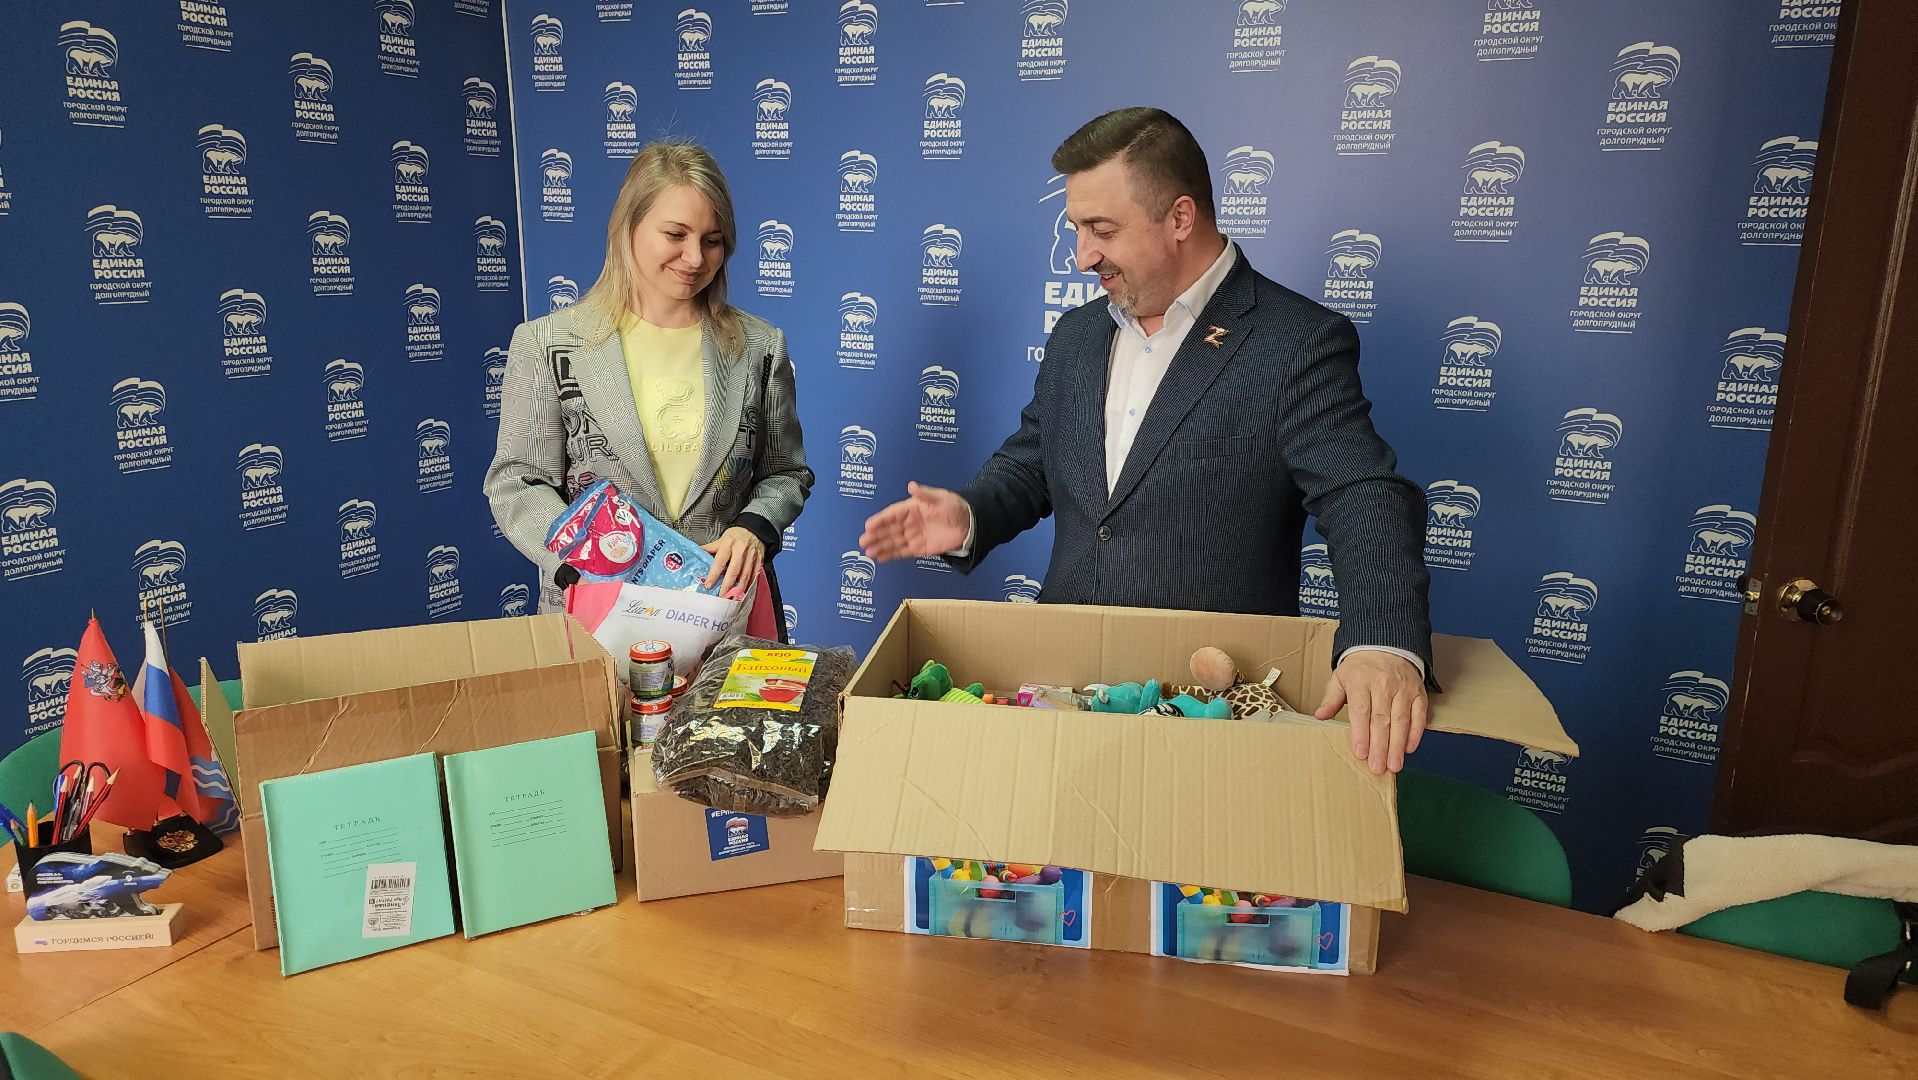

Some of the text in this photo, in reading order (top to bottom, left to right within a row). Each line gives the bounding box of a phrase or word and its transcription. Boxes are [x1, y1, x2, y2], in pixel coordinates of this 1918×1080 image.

[180, 1, 226, 16] ЕДИНАЯ
[180, 11, 227, 26] РОССИЯ
[1485, 11, 1540, 23] ЕДИНАЯ
[1235, 26, 1281, 37] ЕДИНАЯ
[1483, 22, 1539, 34] РОССИЯ
[380, 35, 414, 46] ЕДИНАЯ
[1022, 38, 1063, 48] ЕДИНАЯ
[1234, 37, 1281, 47] РОССИЯ
[1474, 36, 1544, 46] ГОРОДСКОЙ ОКРУГ
[381, 44, 415, 56] РОССИЯ
[839, 46, 874, 56] ЕДИНАЯ
[1022, 47, 1062, 57] РОССИЯ
[1477, 45, 1537, 56] ДОЛГОПРУДНЫЙ
[534, 56, 562, 64] ЕДИНАЯ
[678, 53, 709, 61] ЕДИНАЯ
[840, 56, 874, 64] РОССИЯ
[679, 61, 710, 69] РОССИЯ
[66, 76, 118, 90] ЕДИНАЯ
[68, 87, 120, 101] РОССИЯ
[63, 102, 128, 113] ГОРОДСКОЙ ОКРУГ
[294, 100, 333, 111] ЕДИНАЯ
[1608, 101, 1668, 112] ЕДИНАЯ
[69, 112, 125, 122] ДОЛГОПРУДНЫЙ
[296, 110, 334, 121] РОССИЯ
[1342, 110, 1391, 120] ЕДИНАЯ
[1607, 112, 1666, 123] РОССИЯ
[466, 119, 496, 128] ЕДИНАЯ
[607, 123, 635, 131] ЕДИНАЯ
[756, 122, 788, 130] ЕДИНАЯ
[924, 120, 961, 129] ЕДИНАЯ
[1341, 120, 1391, 130] РОССИЯ
[467, 128, 497, 137] РОССИЯ
[607, 131, 636, 139] РОССИЯ
[756, 131, 788, 139] РОССИЯ
[924, 129, 961, 138] РОССИЯ
[1597, 127, 1644, 136] ГОРОДСКОЙ
[1334, 133, 1373, 141] ГОРОДСКОЙ
[1600, 136, 1664, 145] ДОЛГОПРУДНЫЙ
[1336, 141, 1390, 151] ДОЛГОПРУДНЫЙ
[203, 175, 246, 185] ЕДИНАЯ
[205, 185, 248, 195] РОССИЯ
[395, 185, 428, 193] ЕДИНАЯ
[396, 194, 429, 202] РОССИЯ
[1219, 195, 1267, 206] ЕДИНАЯ
[1461, 197, 1514, 206] ЕДИНАЯ
[840, 203, 874, 211] РОССИЯ
[1219, 206, 1266, 216] РОССИЯ
[1460, 207, 1513, 216] РОССИЯ
[1747, 208, 1807, 217] РОССИЯ
[1451, 220, 1493, 228] ГОРОДСКОЙ
[1454, 229, 1512, 237] ДОЛГОПРУДНЫЙ
[93, 259, 143, 269] ЕДИНАЯ
[312, 257, 349, 265] ЕДИНАЯ
[759, 261, 790, 269] ЕДИНАЯ
[94, 269, 145, 279] РОССИЯ
[314, 266, 350, 274] РОССИЯ
[760, 270, 791, 278] РОССИЯ
[923, 268, 958, 276] ЕДИНАЯ
[90, 282, 129, 290] ГОРОДСКОЙ
[923, 277, 958, 285] РОССИЯ
[1325, 280, 1373, 289] ЕДИНАЯ
[95, 290, 149, 300] ДОЛГОПРУДНЫЙ
[1323, 290, 1372, 300] РОССИЯ
[1580, 287, 1638, 296] ЕДИНАЯ
[1579, 297, 1637, 307] РОССИЯ
[1573, 320, 1635, 328] ДОЛГОПРУДНЫЙ
[408, 326, 439, 334] ЕДИНАЯ
[224, 336, 266, 347] ЕДИНАЯ
[409, 333, 440, 342] РОССИЯ
[841, 333, 873, 341] ЕДИНАЯ
[225, 345, 267, 356] РОССИЯ
[841, 341, 873, 350] РОССИЯ
[1440, 367, 1492, 377] ЕДИНАЯ
[18, 376, 41, 385] ОКРУГ
[1439, 376, 1491, 387] РОССИЯ
[1718, 382, 1778, 393] ЕДИНАЯ
[1432, 389, 1472, 397] ГОРОДСКОЙ
[1434, 398, 1490, 407] ДОЛГОПРУДНЫЙ
[1716, 393, 1777, 405] РОССИЯ
[328, 401, 363, 412] ЕДИНАЯ
[921, 406, 955, 415] ЕДИНАЯ
[329, 410, 364, 421] РОССИЯ
[921, 414, 955, 424] РОССИЯ
[117, 426, 165, 439] ЕДИНАЯ
[119, 435, 167, 450] РОССИЯ
[651, 443, 701, 453] LILBEA
[114, 447, 174, 460] ГОРОДСКОЙ ОКРУГ
[119, 455, 171, 470] ДОЛГОПРУДНЫЙ
[419, 456, 449, 467] ЕДИНАЯ
[1556, 457, 1612, 469] ЕДИНАЯ
[420, 463, 450, 475] РОССИЯ
[841, 464, 873, 473] ЕДИНАЯ
[841, 471, 873, 481] РОССИЯ
[1555, 468, 1610, 480] РОССИЯ
[1547, 480, 1590, 491] ГОРОДСКОЙ
[242, 486, 282, 500] ЕДИНАЯ
[1549, 489, 1609, 499] ДОЛГОПРУДНЫЙ
[243, 494, 283, 509] РОССИЯ
[1, 528, 57, 545] ЕДИНАЯ
[3, 538, 58, 556] РОССИЯ
[341, 536, 375, 551] ЕДИНАЯ
[44, 549, 66, 560] ОКРУГ
[342, 546, 376, 562] РОССИЯ
[643, 540, 667, 569] DIAPER
[1686, 554, 1746, 568] ЕДИНАЯ
[4, 558, 63, 577] ДОЛГОПРУДНЫЙ
[1685, 564, 1744, 578] РОССИЯ
[429, 578, 458, 593] ЕДИНАЯ
[139, 583, 185, 601] ЕДИНАЯ
[430, 586, 460, 603] РОССИЯ
[841, 587, 872, 597] ЕДИНАЯ
[841, 594, 872, 604] РОССИЯ
[666, 609, 733, 632] DIAPER HO
[1534, 618, 1588, 632] ЕДИНАЯ
[1533, 627, 1586, 641] РОССИЯ
[1660, 716, 1718, 732] ЕДИНАЯ
[1659, 726, 1716, 742] РОССИЯ
[1515, 768, 1566, 784] ЕДИНАЯ
[1514, 777, 1565, 793] РОССИЯ
[505, 789, 545, 802] ТЕТРАДЬ
[334, 816, 381, 831] ТЕТРАДЬ
[52, 932, 154, 945] ГОРДИМСЯ РОССИЕЙ!
